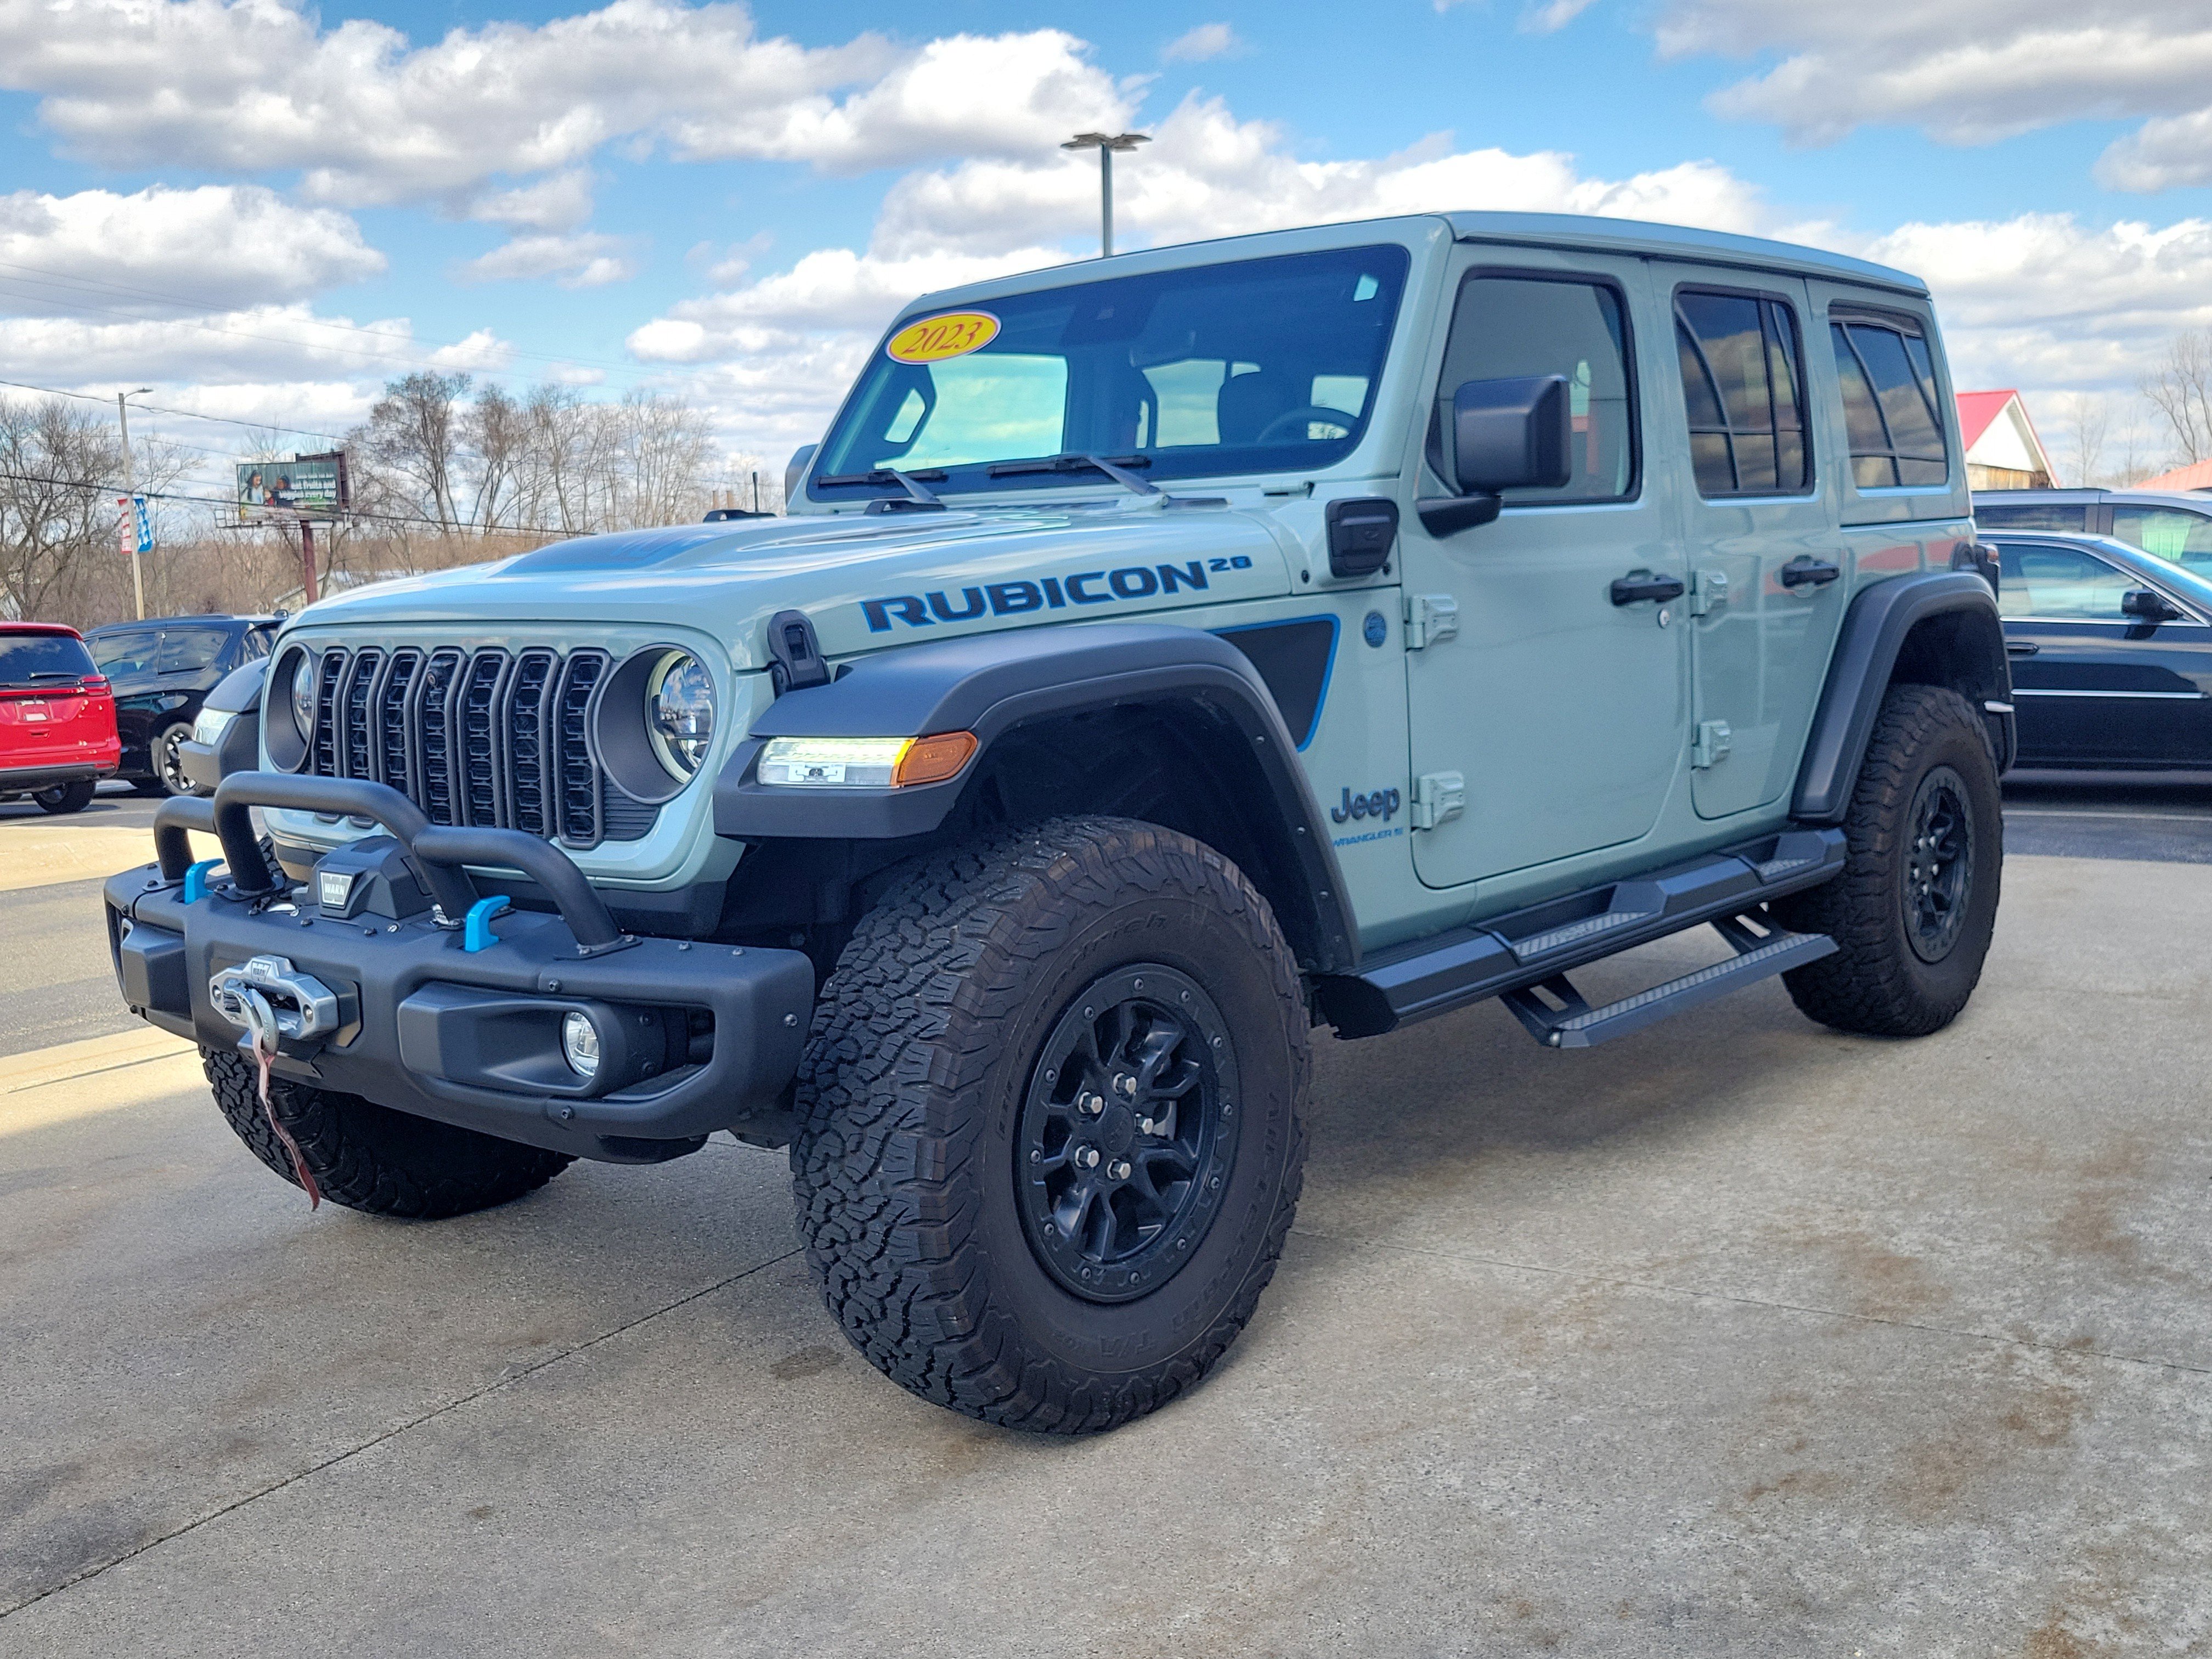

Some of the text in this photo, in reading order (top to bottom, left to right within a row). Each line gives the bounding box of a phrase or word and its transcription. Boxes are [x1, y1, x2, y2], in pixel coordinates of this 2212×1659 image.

[900, 321, 984, 355] 2023
[860, 555, 1252, 634] RUBICON 20
[1331, 786, 1400, 823] Jeep
[324, 883, 345, 895] WARN
[252, 967, 266, 977] WARN
